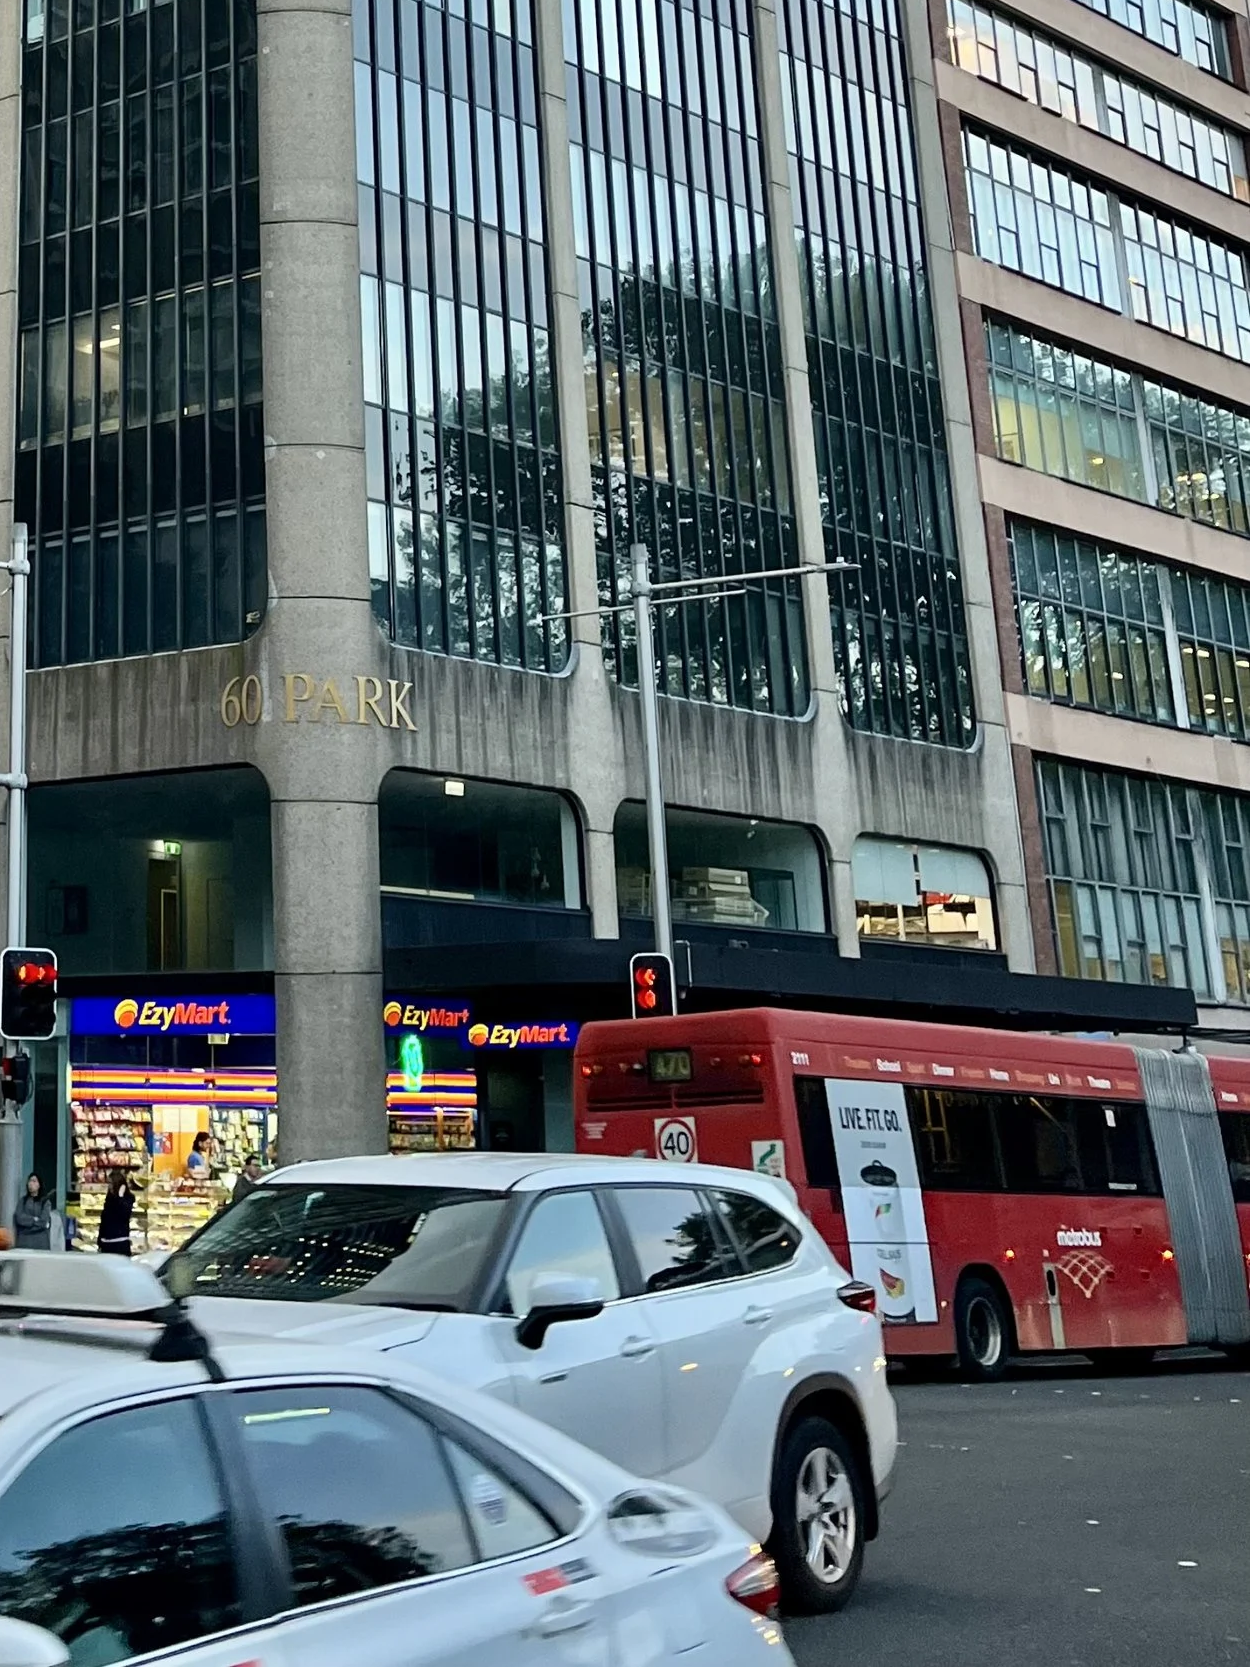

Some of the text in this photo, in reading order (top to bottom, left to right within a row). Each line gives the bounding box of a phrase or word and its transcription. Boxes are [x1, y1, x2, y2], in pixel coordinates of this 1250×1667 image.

[221, 673, 419, 732] 60 PARK
[138, 1001, 230, 1031] EzyMart
[402, 1005, 470, 1031] EzyMart
[489, 1023, 568, 1049] EzyMart
[663, 1131, 690, 1156] 40
[1056, 1227, 1102, 1246] metrobus
